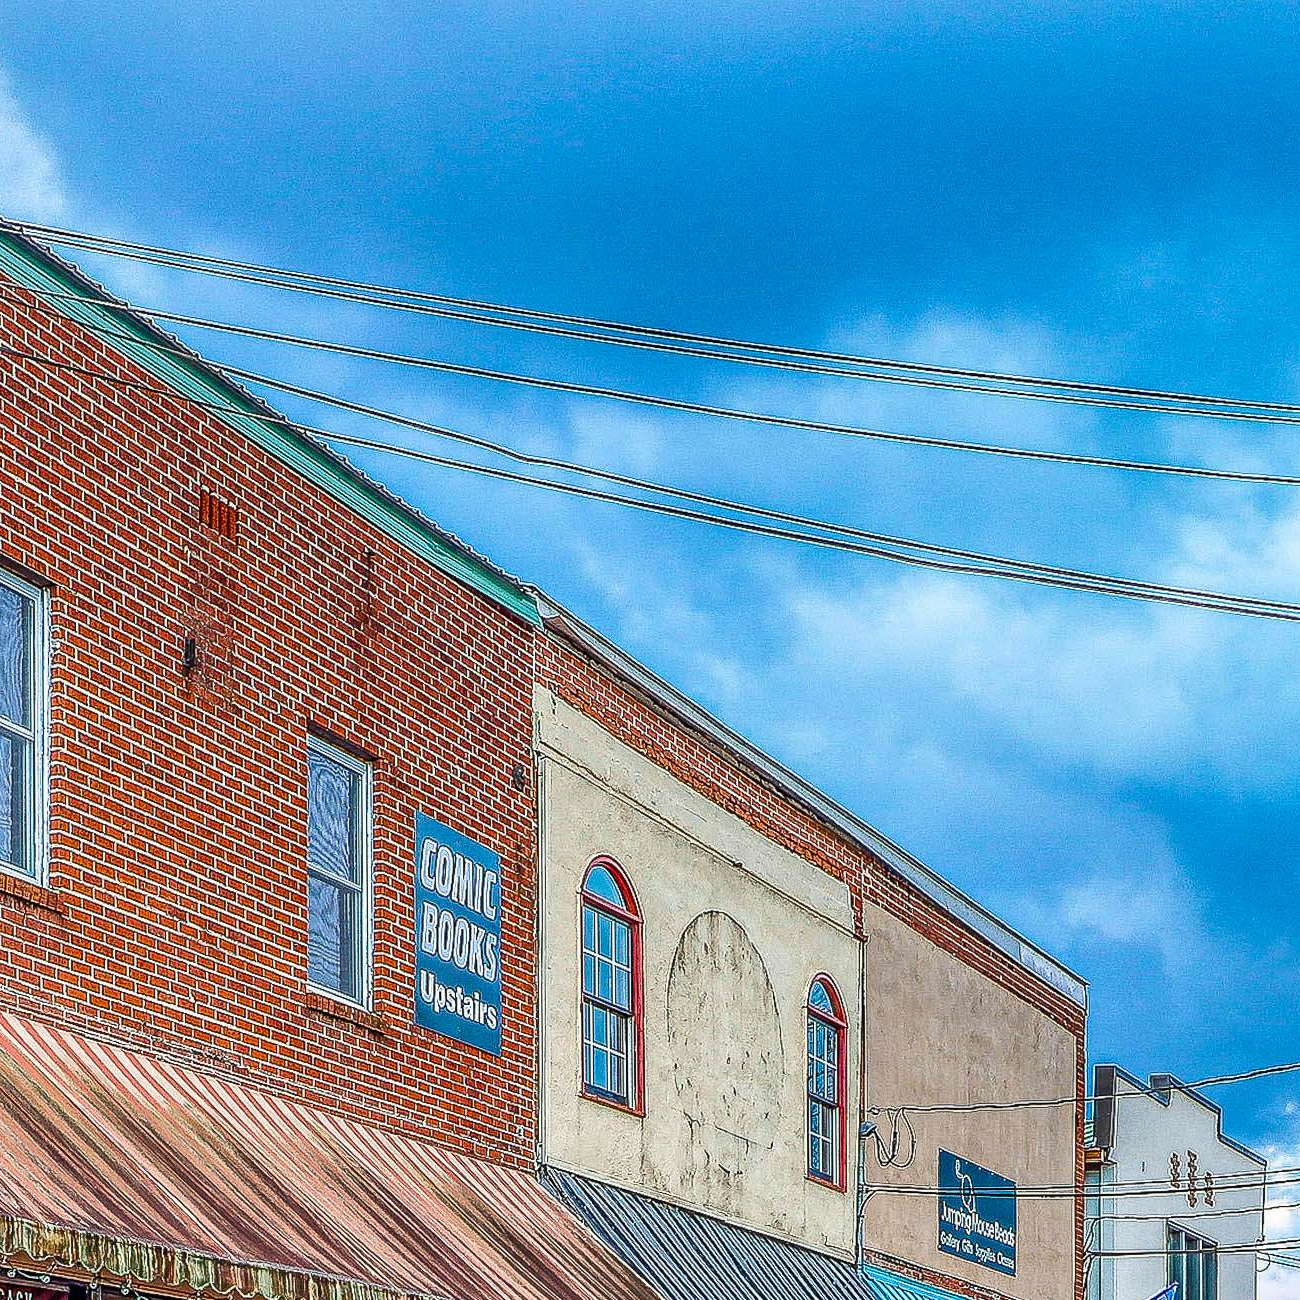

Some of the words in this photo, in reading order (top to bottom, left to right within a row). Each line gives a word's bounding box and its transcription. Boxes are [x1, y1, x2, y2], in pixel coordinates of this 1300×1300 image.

[420, 836, 498, 921] COMIC
[421, 900, 499, 983] BOOKS
[420, 969, 499, 1031] Upstairs
[941, 1201, 973, 1235] Jumping
[972, 1213, 995, 1240] Mouse
[994, 1221, 1016, 1247] Beads
